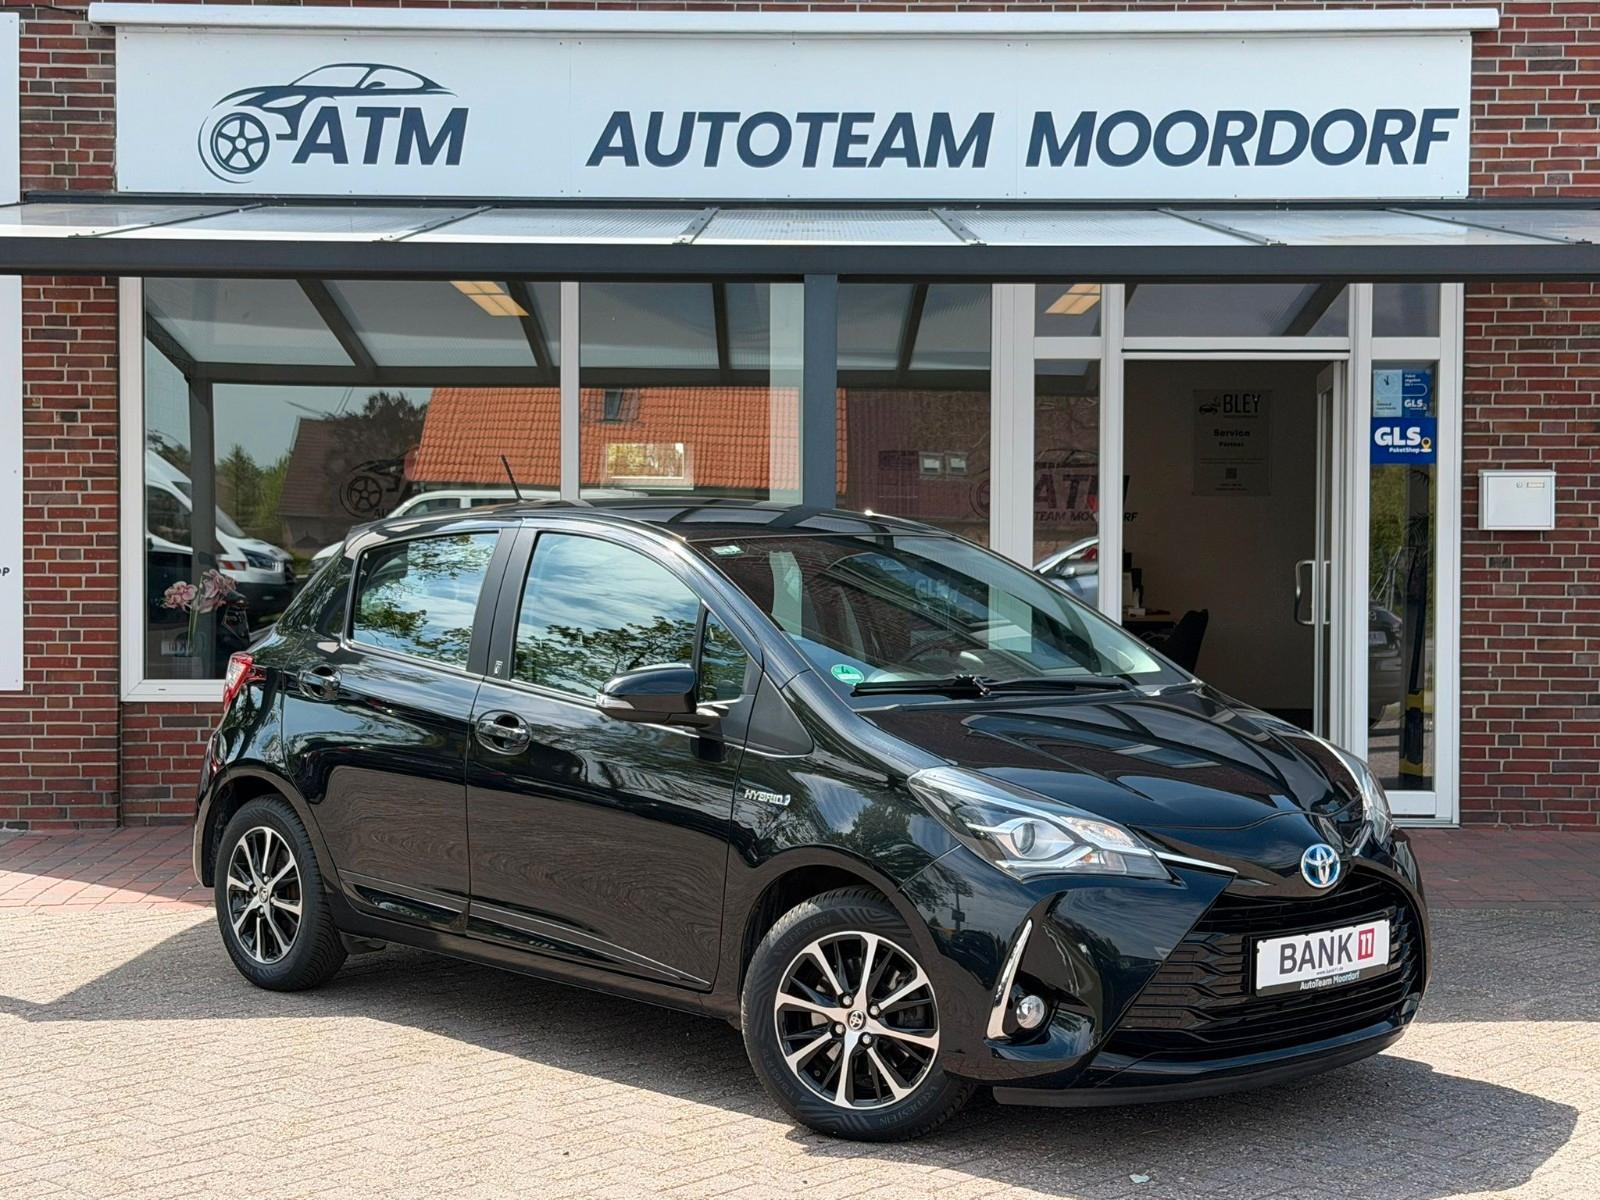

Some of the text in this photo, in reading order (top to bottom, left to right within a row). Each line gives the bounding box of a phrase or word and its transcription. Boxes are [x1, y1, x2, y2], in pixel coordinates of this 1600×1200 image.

[293, 106, 469, 166] ATM
[586, 108, 1460, 169] AUTOTEAM MOORDORF
[1223, 393, 1261, 413] BLEY
[1404, 399, 1423, 408] GLS
[1213, 428, 1250, 437] Service
[1374, 426, 1421, 446] GLS
[0, 567, 10, 576] P
[744, 788, 784, 805] HYBRID
[1279, 930, 1373, 975] BANK 11
[1300, 970, 1360, 991] AutoTeam Moordorf
